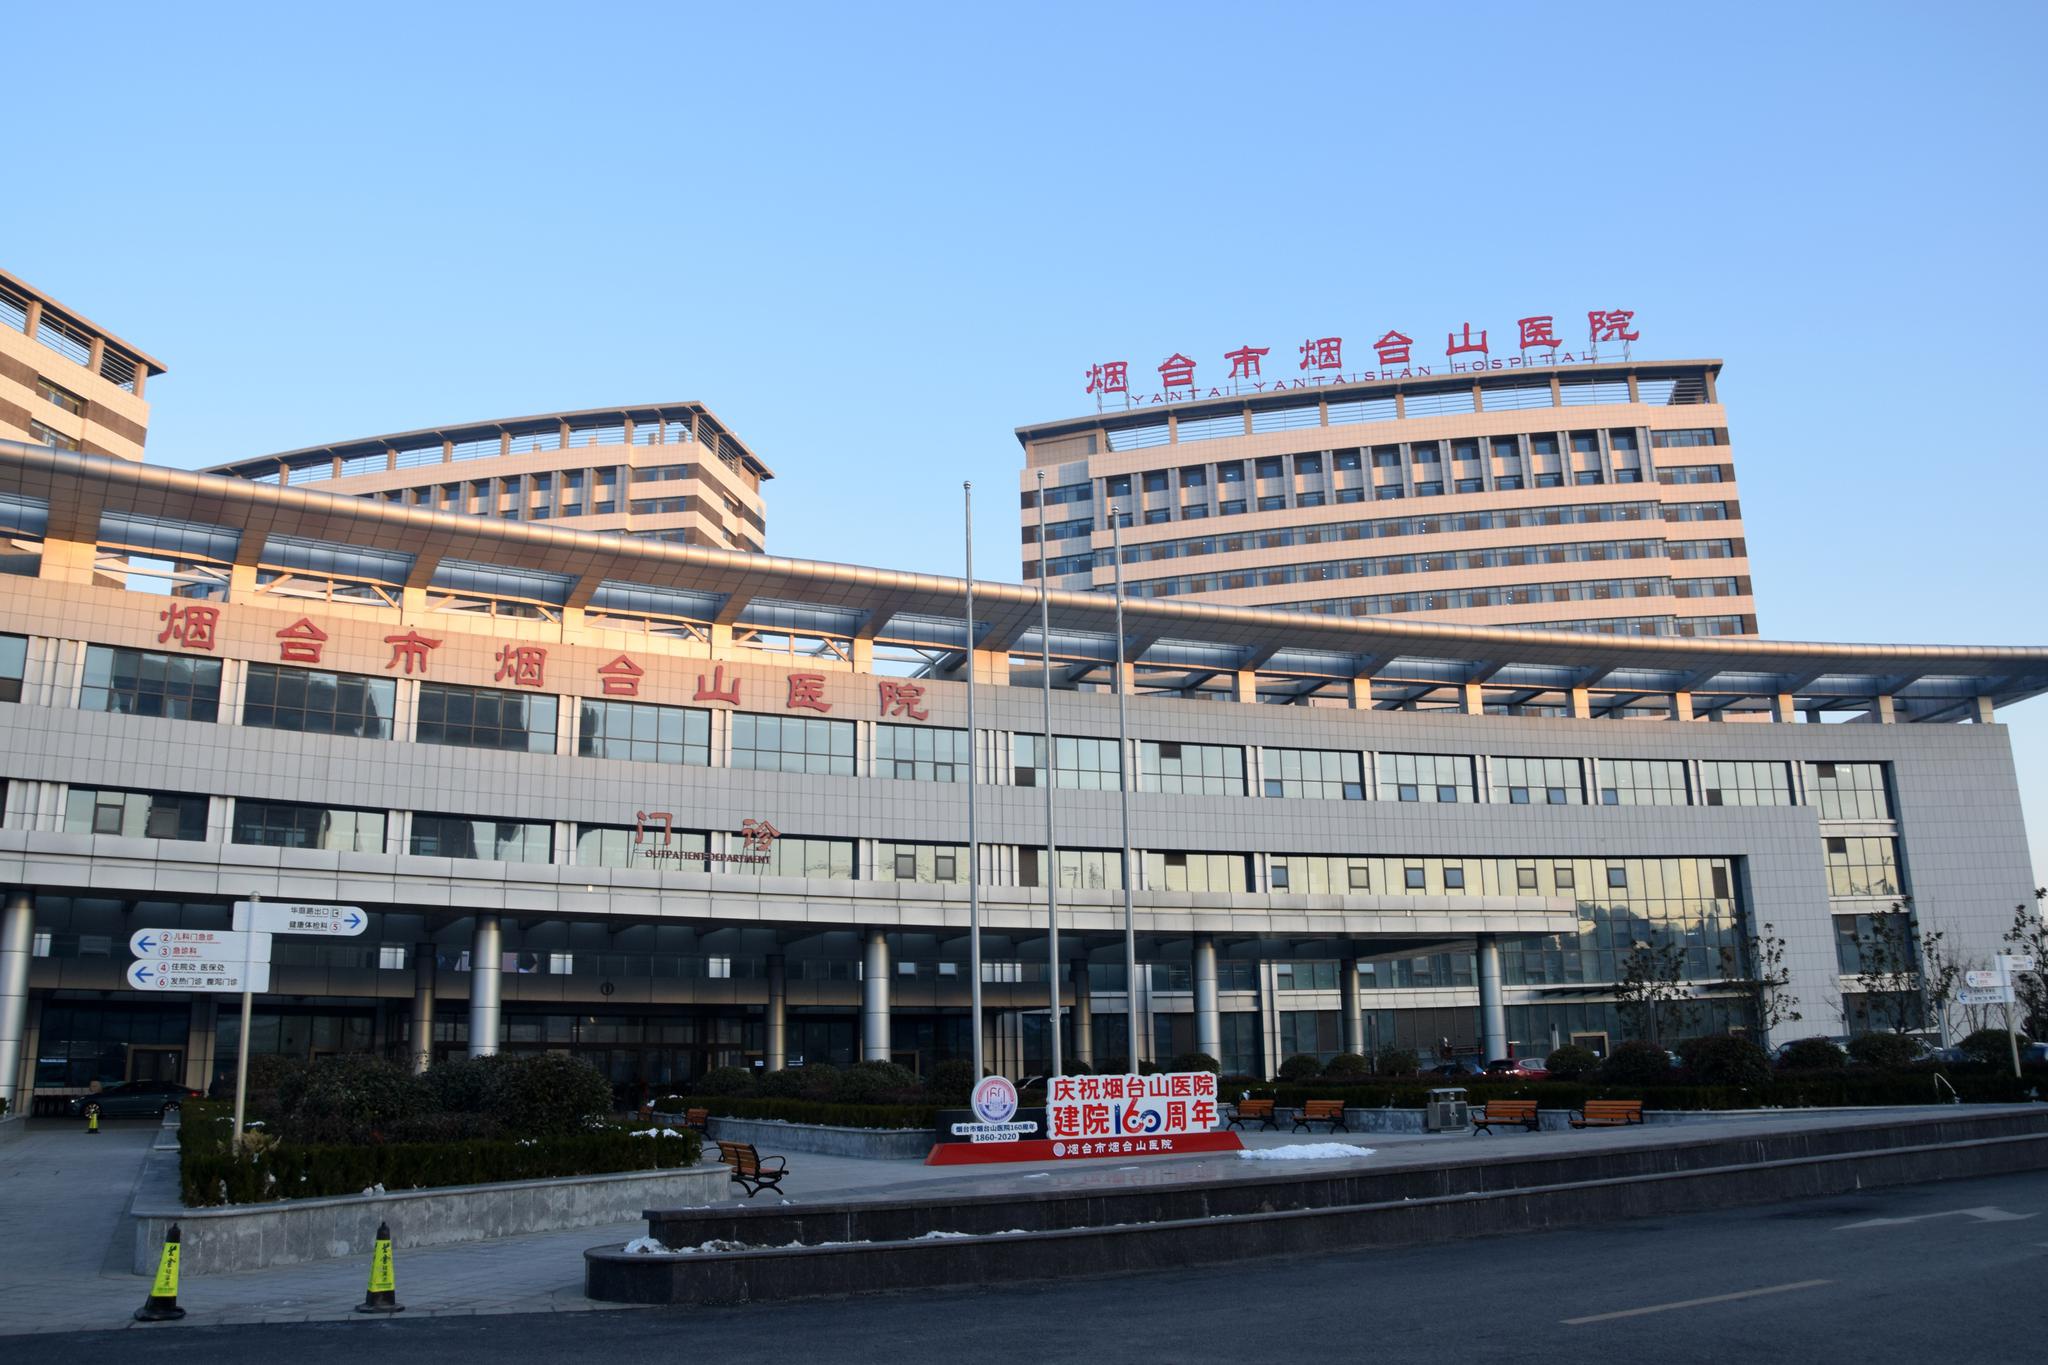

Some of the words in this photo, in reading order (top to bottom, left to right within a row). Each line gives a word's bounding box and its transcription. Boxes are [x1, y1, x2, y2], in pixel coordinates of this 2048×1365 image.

[1086, 309, 1639, 394] 烟台市烟台山医院
[1131, 386, 1230, 405] YANTAI
[1253, 362, 1431, 393] YANTAISHAN
[1453, 352, 1596, 372] HOSPITAL
[158, 602, 930, 721] 烟台市烟台山医院
[635, 810, 782, 851] 门诊
[645, 850, 705, 861] OUTPATIENT
[708, 852, 771, 864] DEPARTMENT
[1054, 1075, 1214, 1101] 庆祝烟台山医院
[976, 1133, 1017, 1141] 1860-2020
[1053, 1098, 1217, 1137] 建院160周年
[1067, 1139, 1173, 1155] 烟台市烟台山医院
